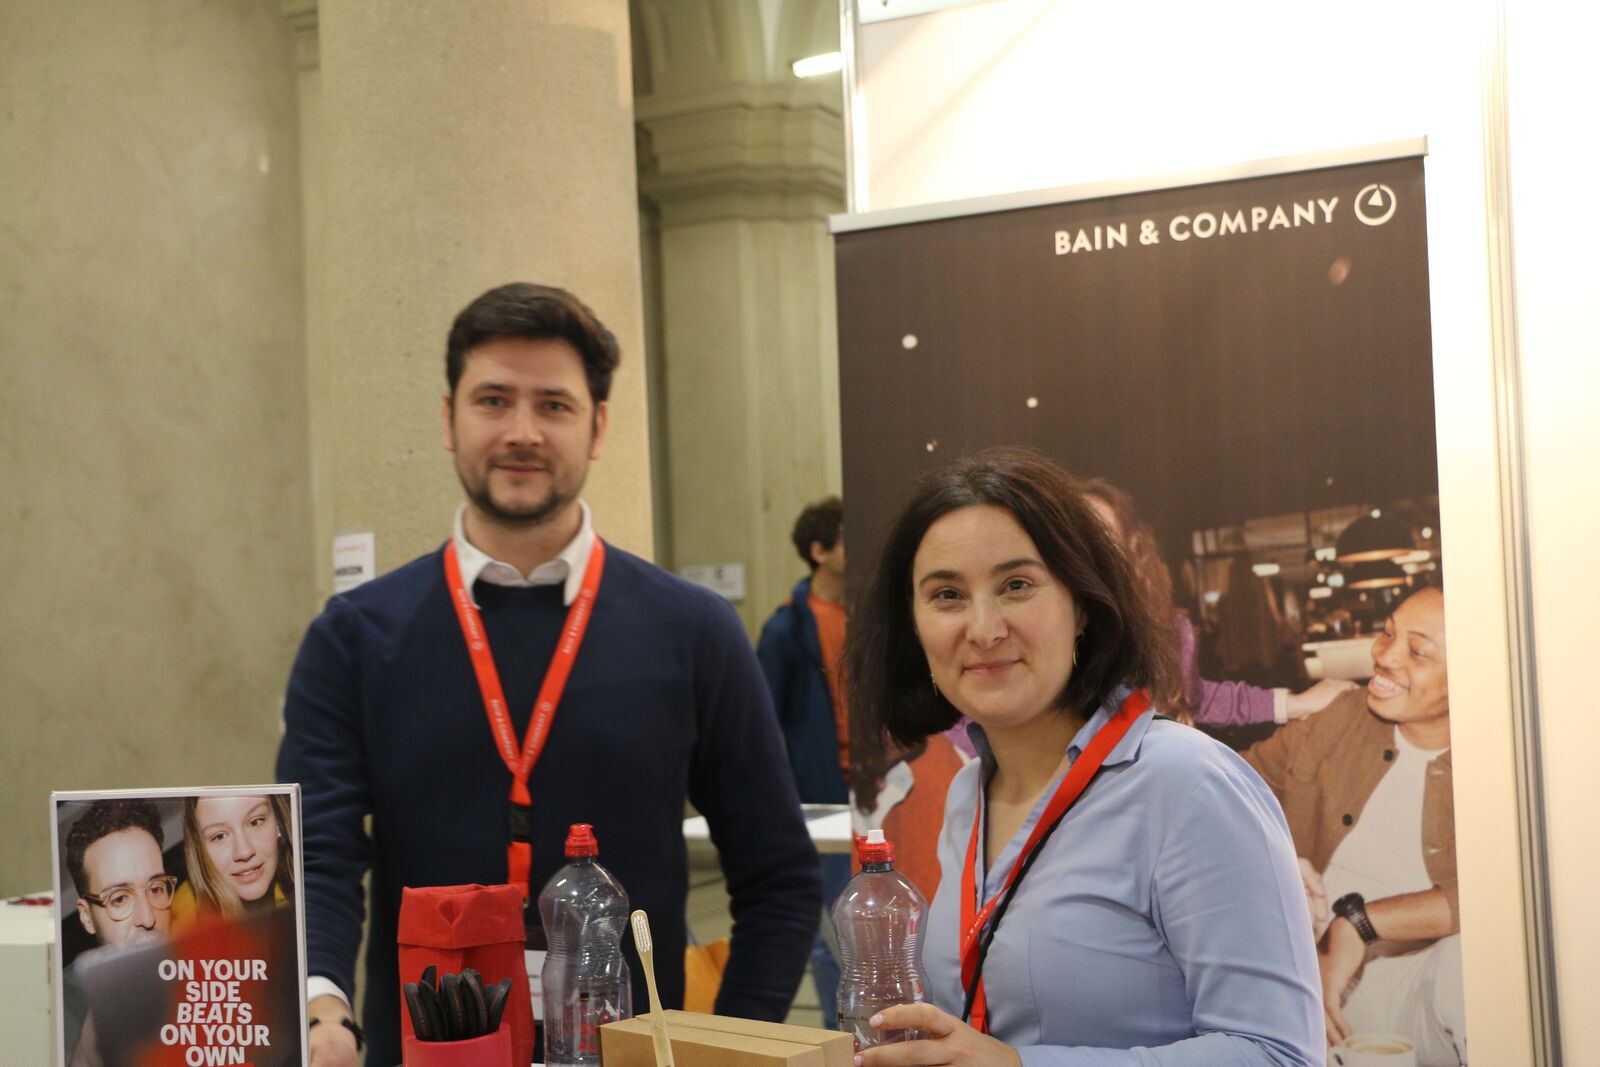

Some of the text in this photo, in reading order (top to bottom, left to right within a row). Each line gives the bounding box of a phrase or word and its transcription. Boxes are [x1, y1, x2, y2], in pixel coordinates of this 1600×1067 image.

[1054, 196, 1339, 255] BAIN & COMPANY
[158, 959, 268, 981] ON YOUR
[185, 981, 241, 1002] SIDE
[177, 1002, 252, 1024] BEATS
[160, 1024, 271, 1046] ON YOUR
[185, 1046, 246, 1067] OWN
